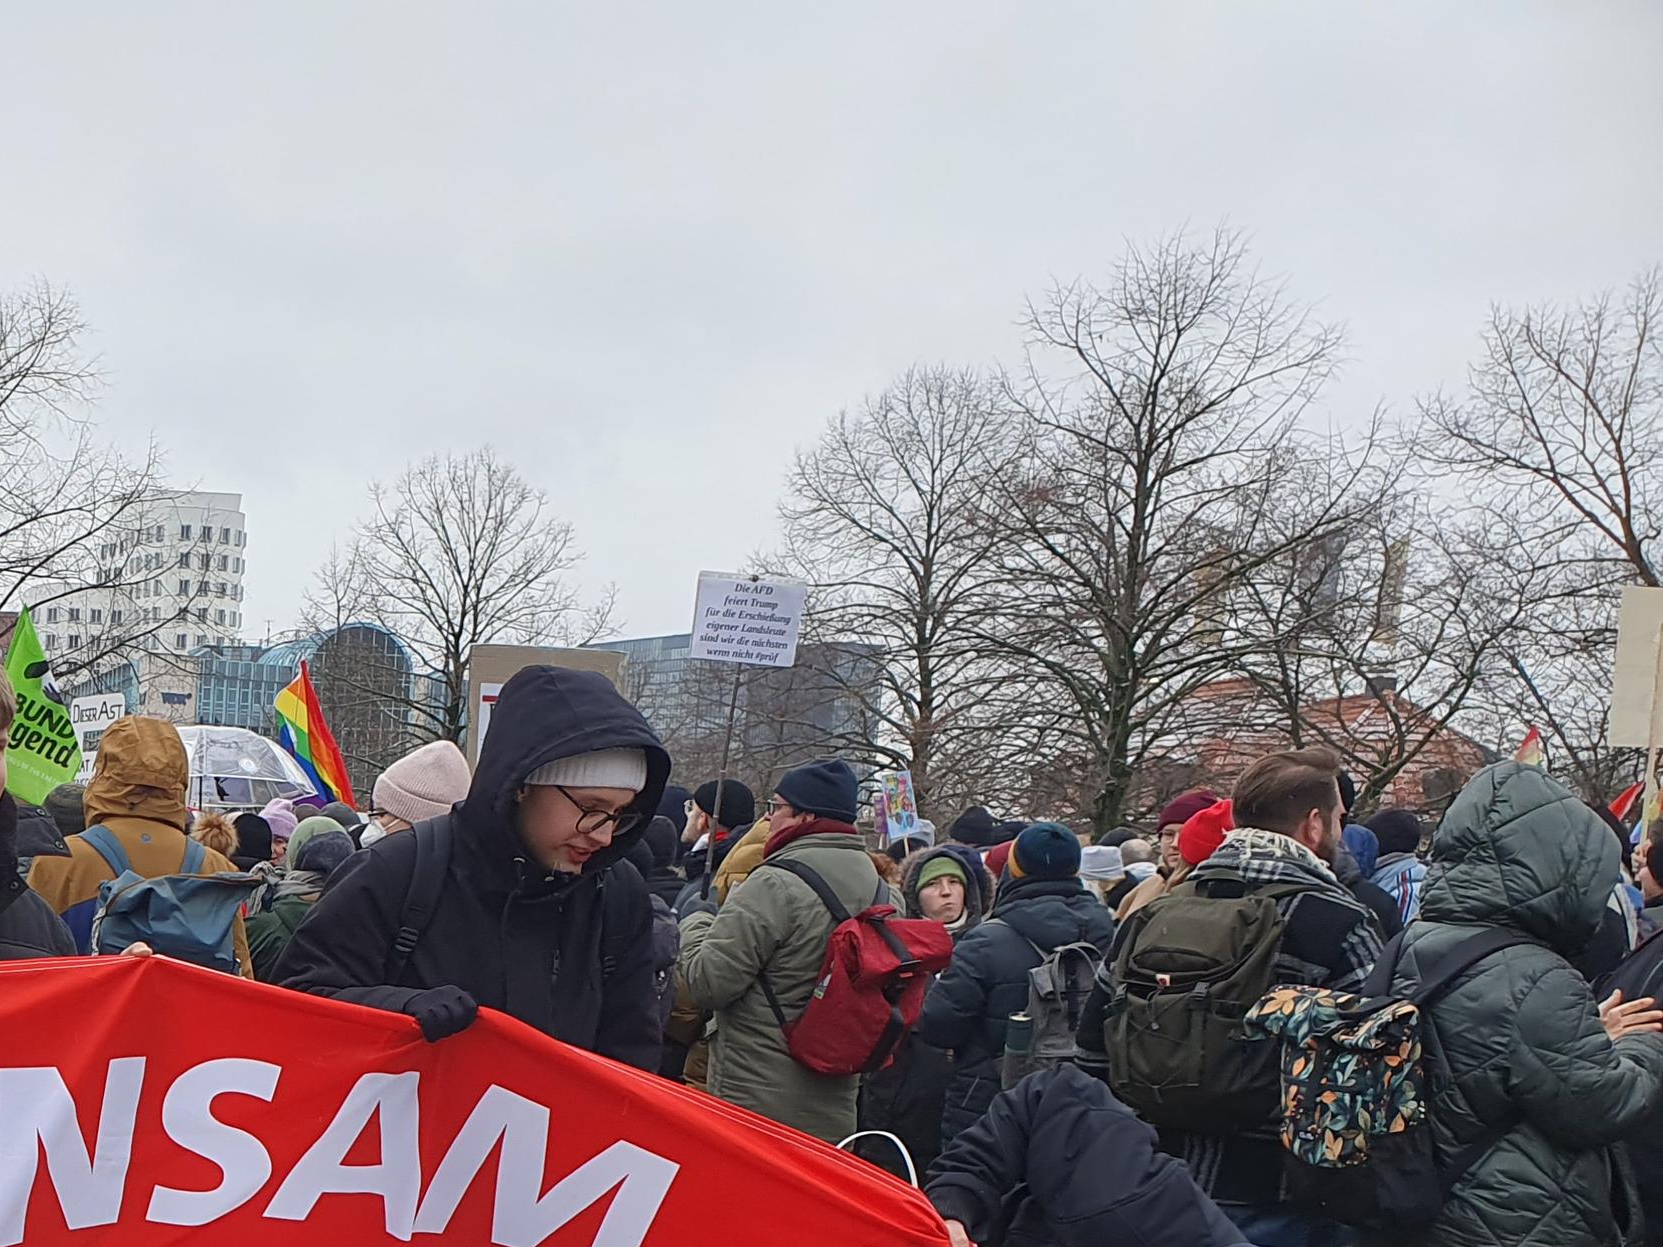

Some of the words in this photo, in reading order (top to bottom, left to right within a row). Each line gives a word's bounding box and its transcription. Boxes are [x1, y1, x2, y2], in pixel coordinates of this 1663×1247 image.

[735, 583, 750, 593] Die
[751, 585, 774, 595] AFD
[724, 595, 748, 606] feiert
[751, 598, 778, 611] Trump
[706, 607, 720, 617] für
[722, 608, 736, 618] die
[738, 610, 791, 626] Erschießung
[706, 621, 739, 632] eigener
[741, 624, 786, 636] Landsleute
[700, 633, 719, 642] sind
[721, 635, 735, 644] wir
[737, 636, 750, 646] die
[751, 639, 788, 649] nächsten
[707, 648, 730, 656] wenn
[732, 649, 754, 659] nicht
[755, 652, 779, 663] #prüf
[98, 701, 123, 721] AST
[8, 720, 78, 768] gend
